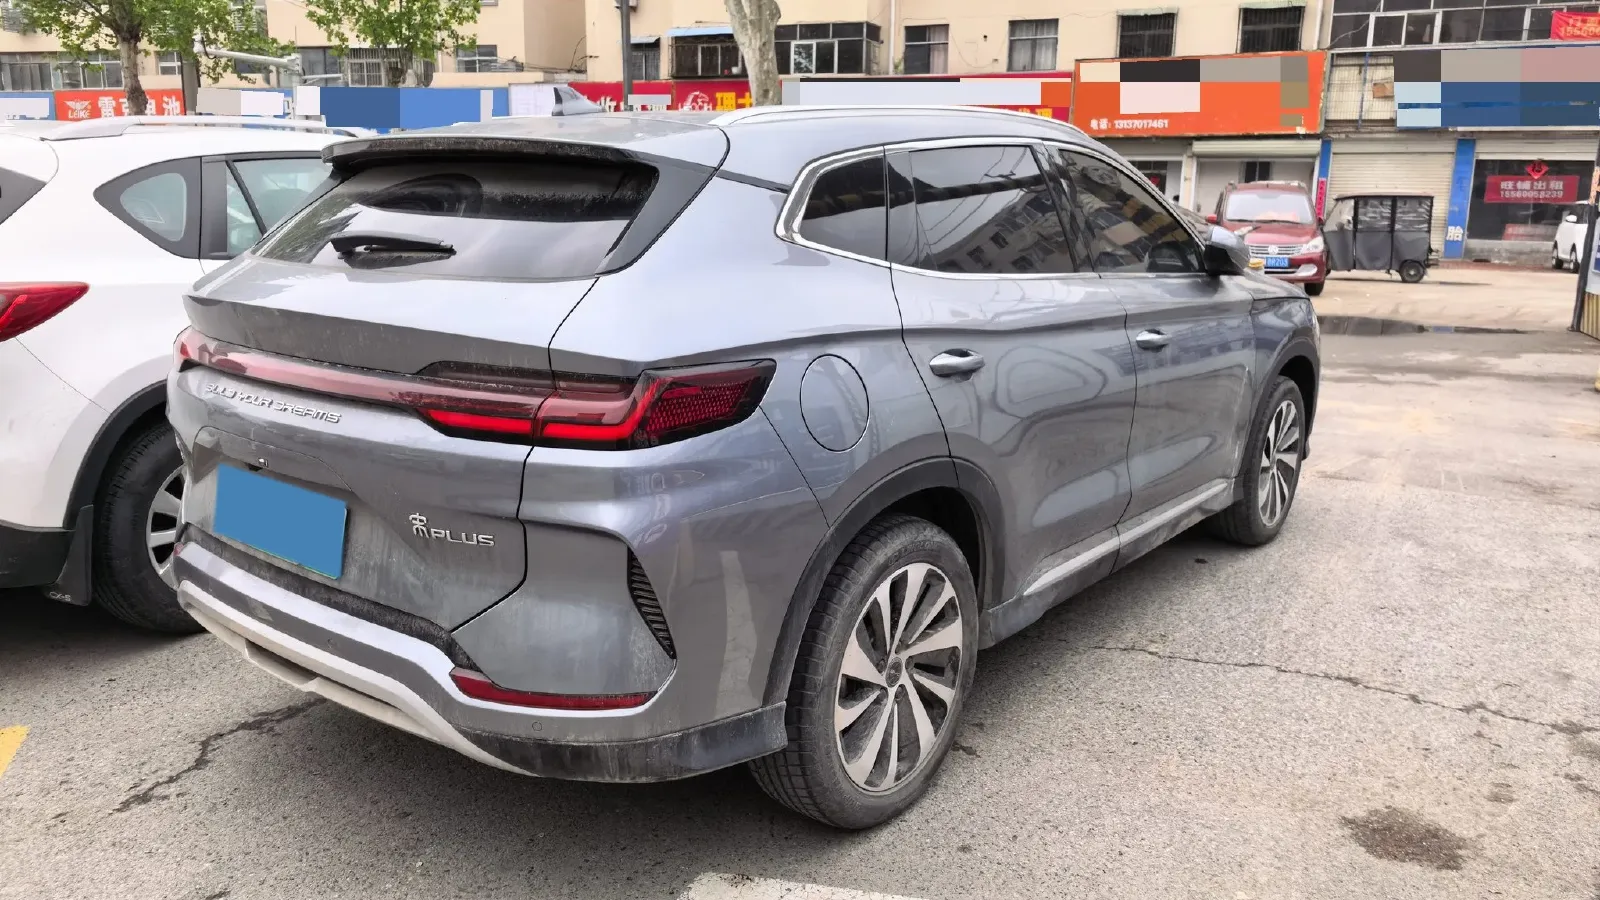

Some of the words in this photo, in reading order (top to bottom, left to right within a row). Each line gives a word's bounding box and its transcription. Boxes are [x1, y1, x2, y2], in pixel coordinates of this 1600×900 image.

[67, 108, 92, 119] LEIKE
[1500, 190, 1564, 199] 15560058239
[1446, 225, 1463, 241] 胎
[205, 383, 238, 399] BUILD
[239, 391, 275, 408] YOUR
[274, 401, 343, 424] DREAMS
[430, 528, 496, 547] PLUS
